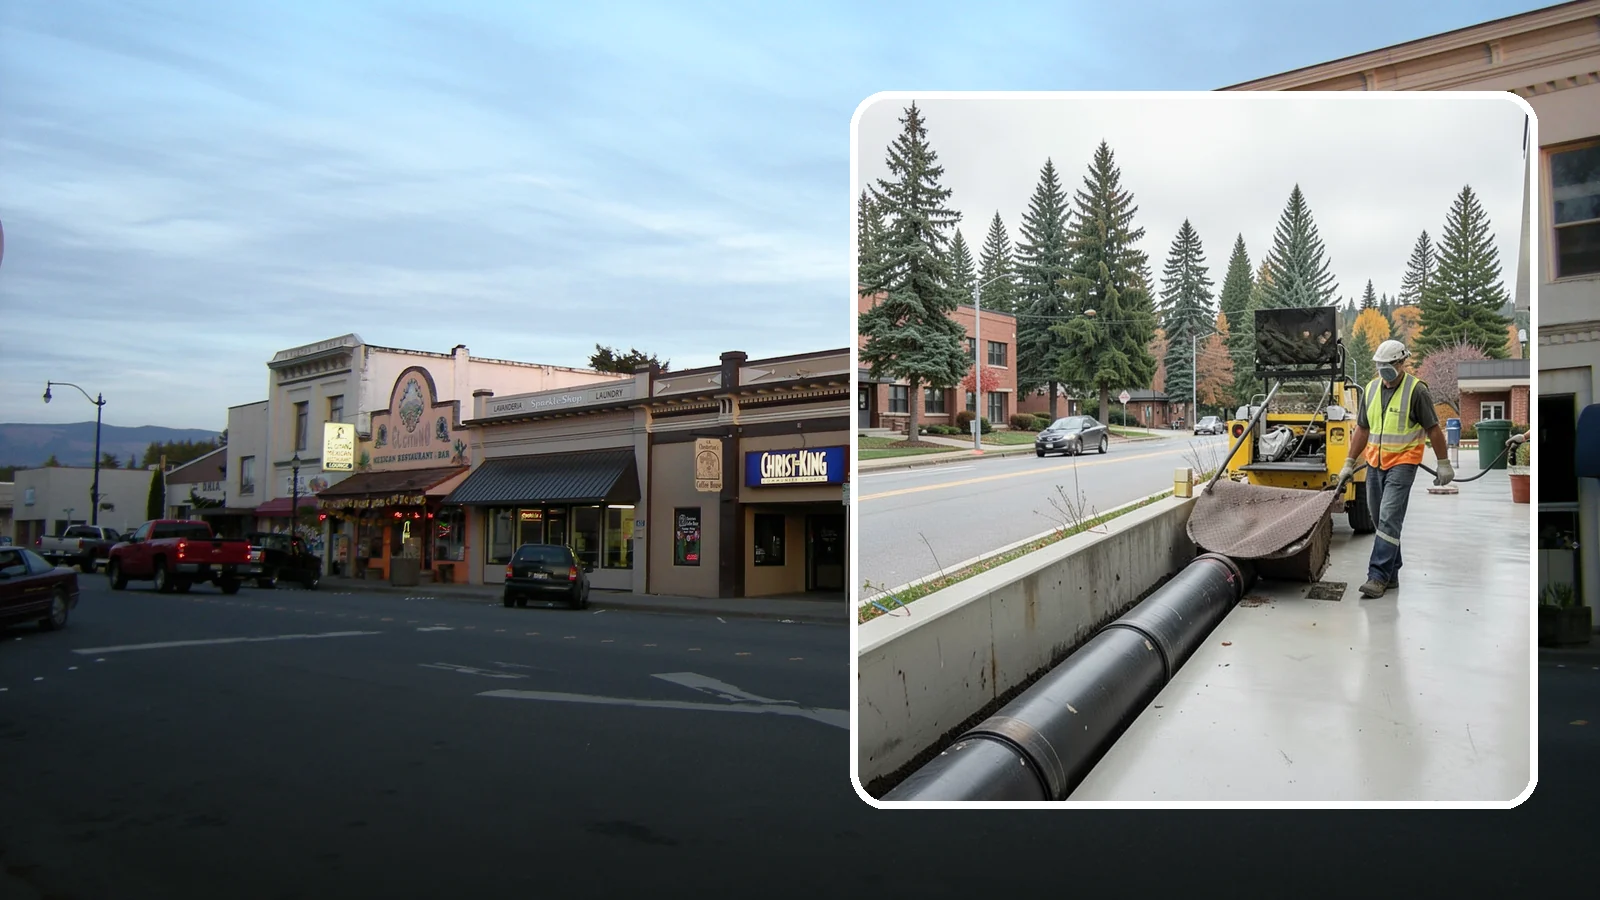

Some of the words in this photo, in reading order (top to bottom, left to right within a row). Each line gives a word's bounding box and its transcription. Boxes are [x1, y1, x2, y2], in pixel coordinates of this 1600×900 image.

[561, 395, 582, 405] Shop
[595, 389, 623, 400] LAUNDRY
[493, 402, 522, 413] LAVANDERIA
[373, 455, 396, 464] MEXICAN
[397, 451, 433, 462] RESTAURANT
[438, 450, 450, 458] BAR
[761, 452, 797, 478] CHRIST
[799, 450, 827, 476] KING
